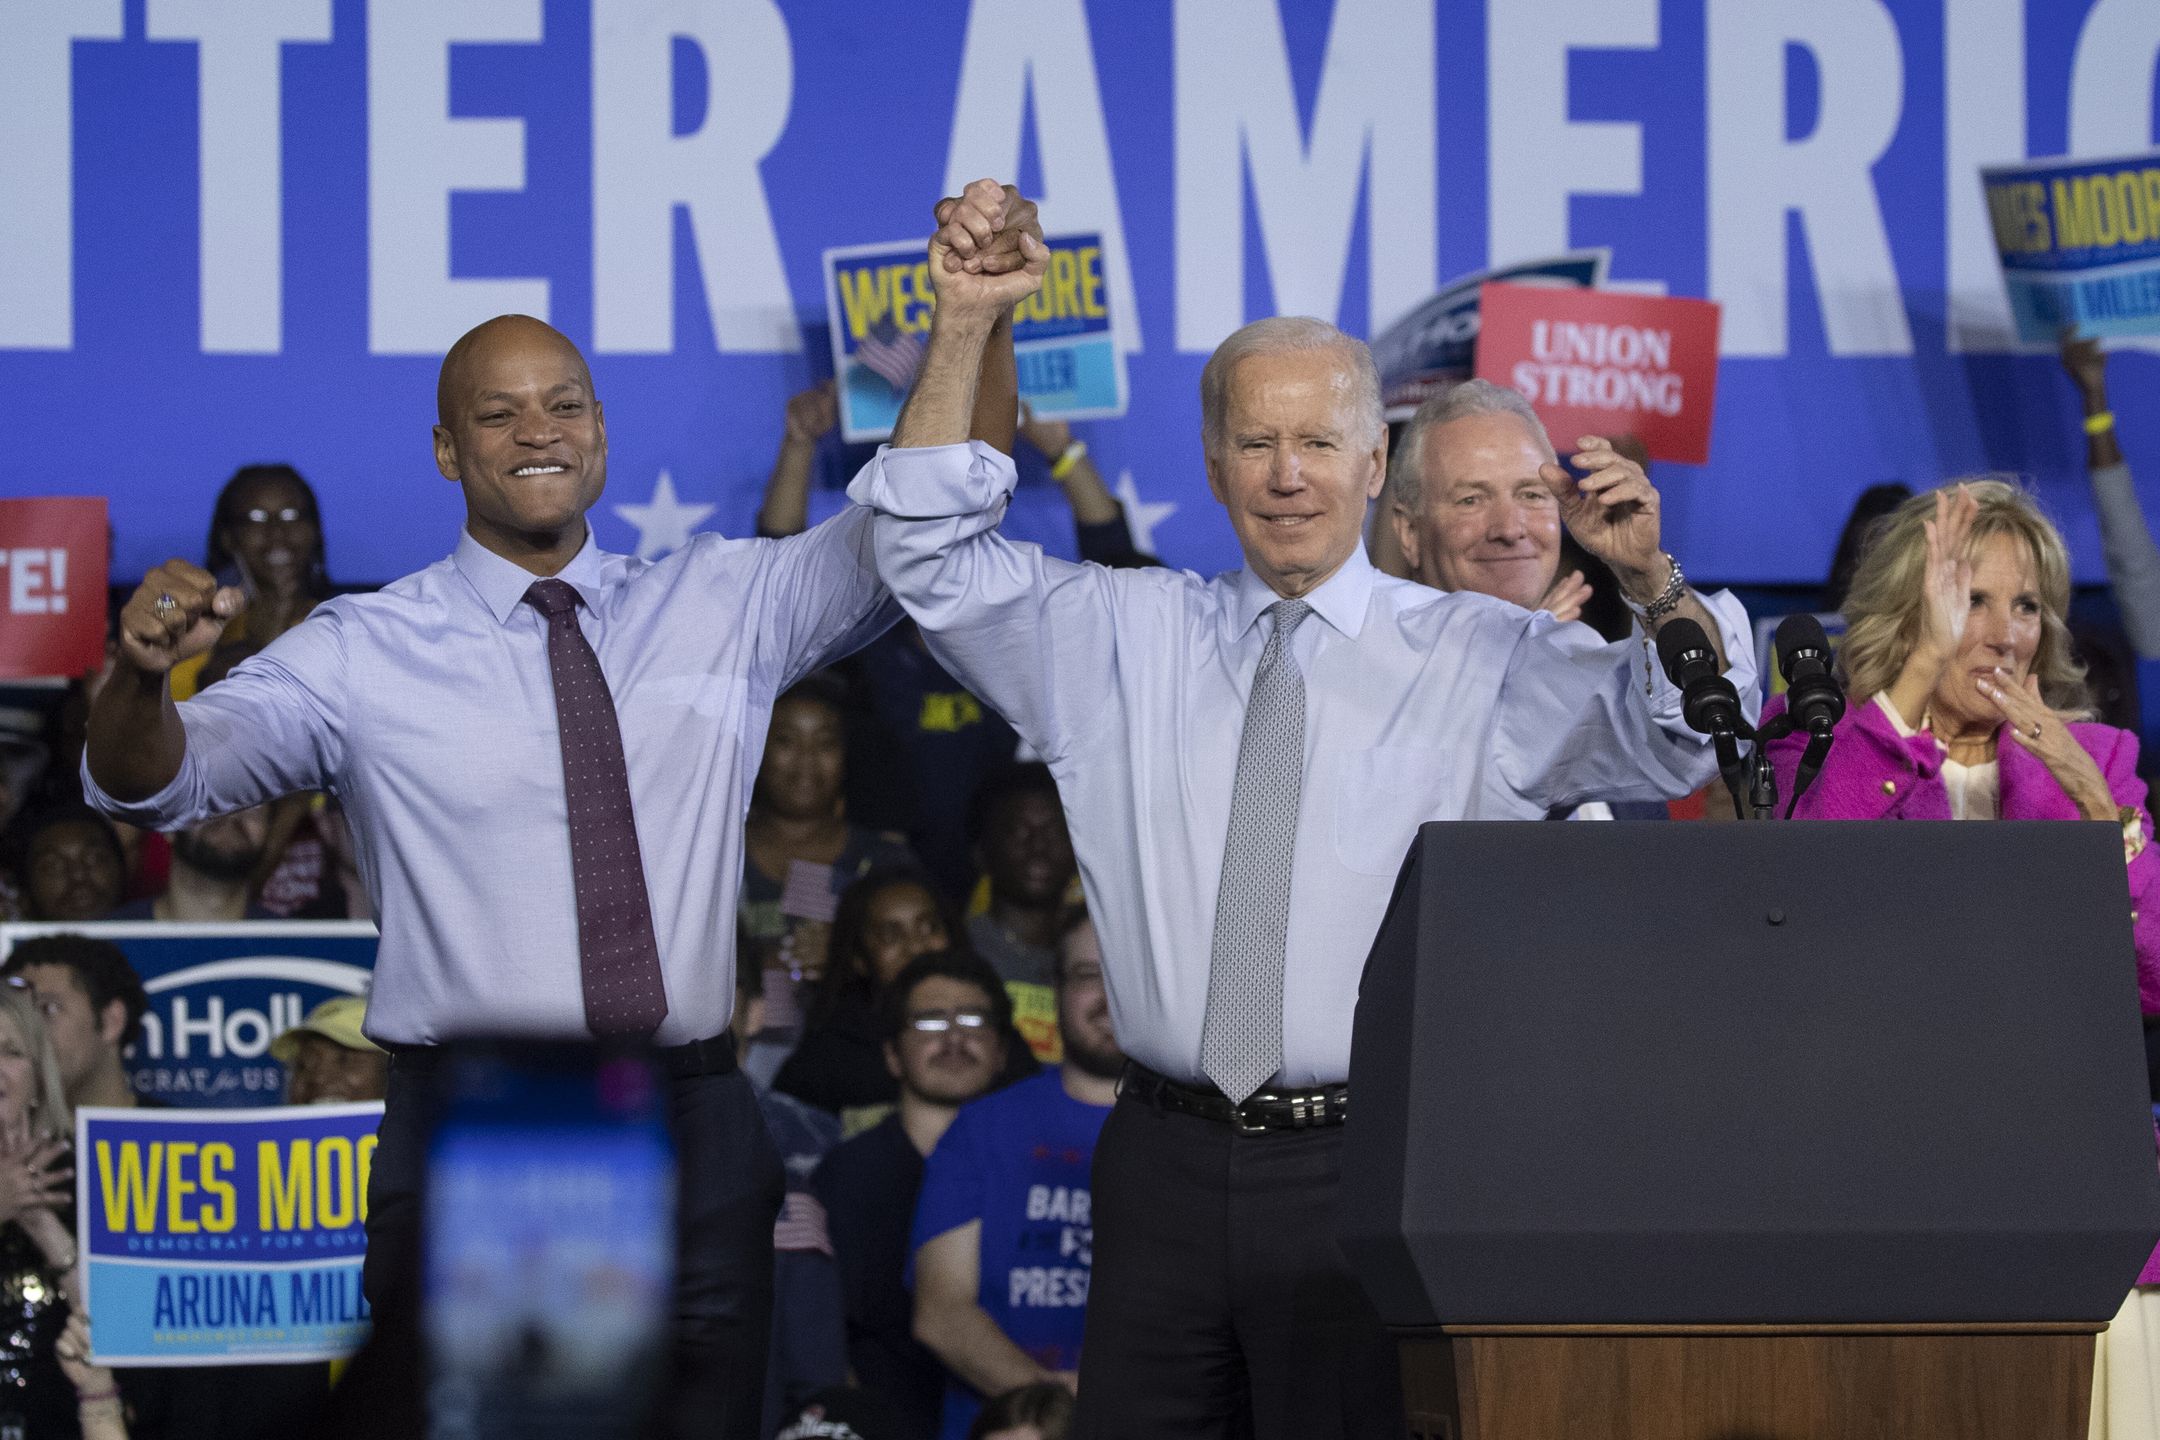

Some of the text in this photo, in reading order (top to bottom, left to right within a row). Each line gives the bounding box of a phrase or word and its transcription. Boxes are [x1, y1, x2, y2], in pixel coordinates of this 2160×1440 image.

[838, 264, 937, 340] WES
[1532, 319, 1672, 370] UNION
[1513, 362, 1683, 417] STRONG
[0, 547, 68, 615] E!
[127, 1067, 209, 1093] CRAT
[96, 1139, 237, 1234] WES
[127, 1236, 249, 1250] DEMOCRAT
[261, 1235, 304, 1247] FOR
[154, 1272, 277, 1329] ARUNA
